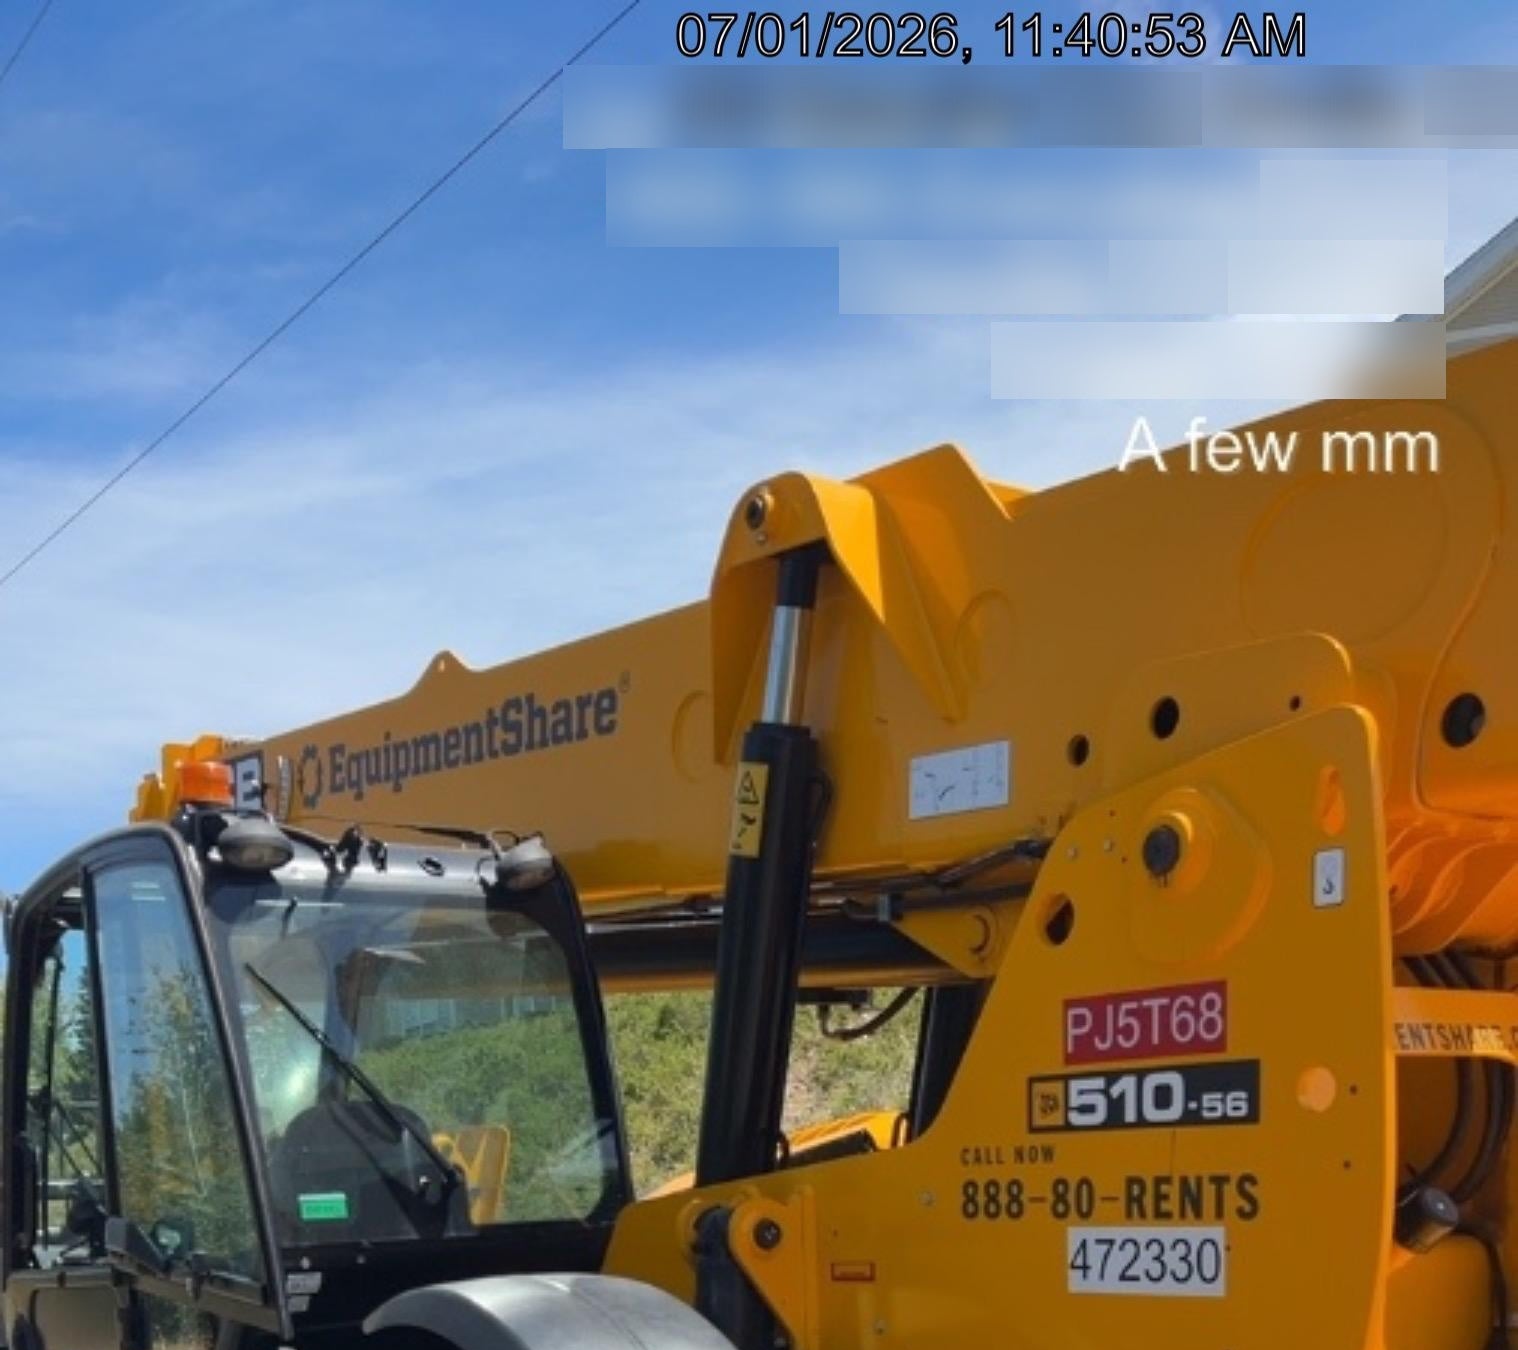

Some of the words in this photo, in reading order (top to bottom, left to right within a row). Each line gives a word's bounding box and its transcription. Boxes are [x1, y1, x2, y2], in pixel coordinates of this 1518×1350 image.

[1067, 991, 1224, 1054] PJ5T68
[960, 1147, 1006, 1168] CALL
[1013, 1144, 1056, 1164] NOW
[961, 1172, 1260, 1221] 888-80-RENTS
[1069, 1237, 1223, 1284] 472330
